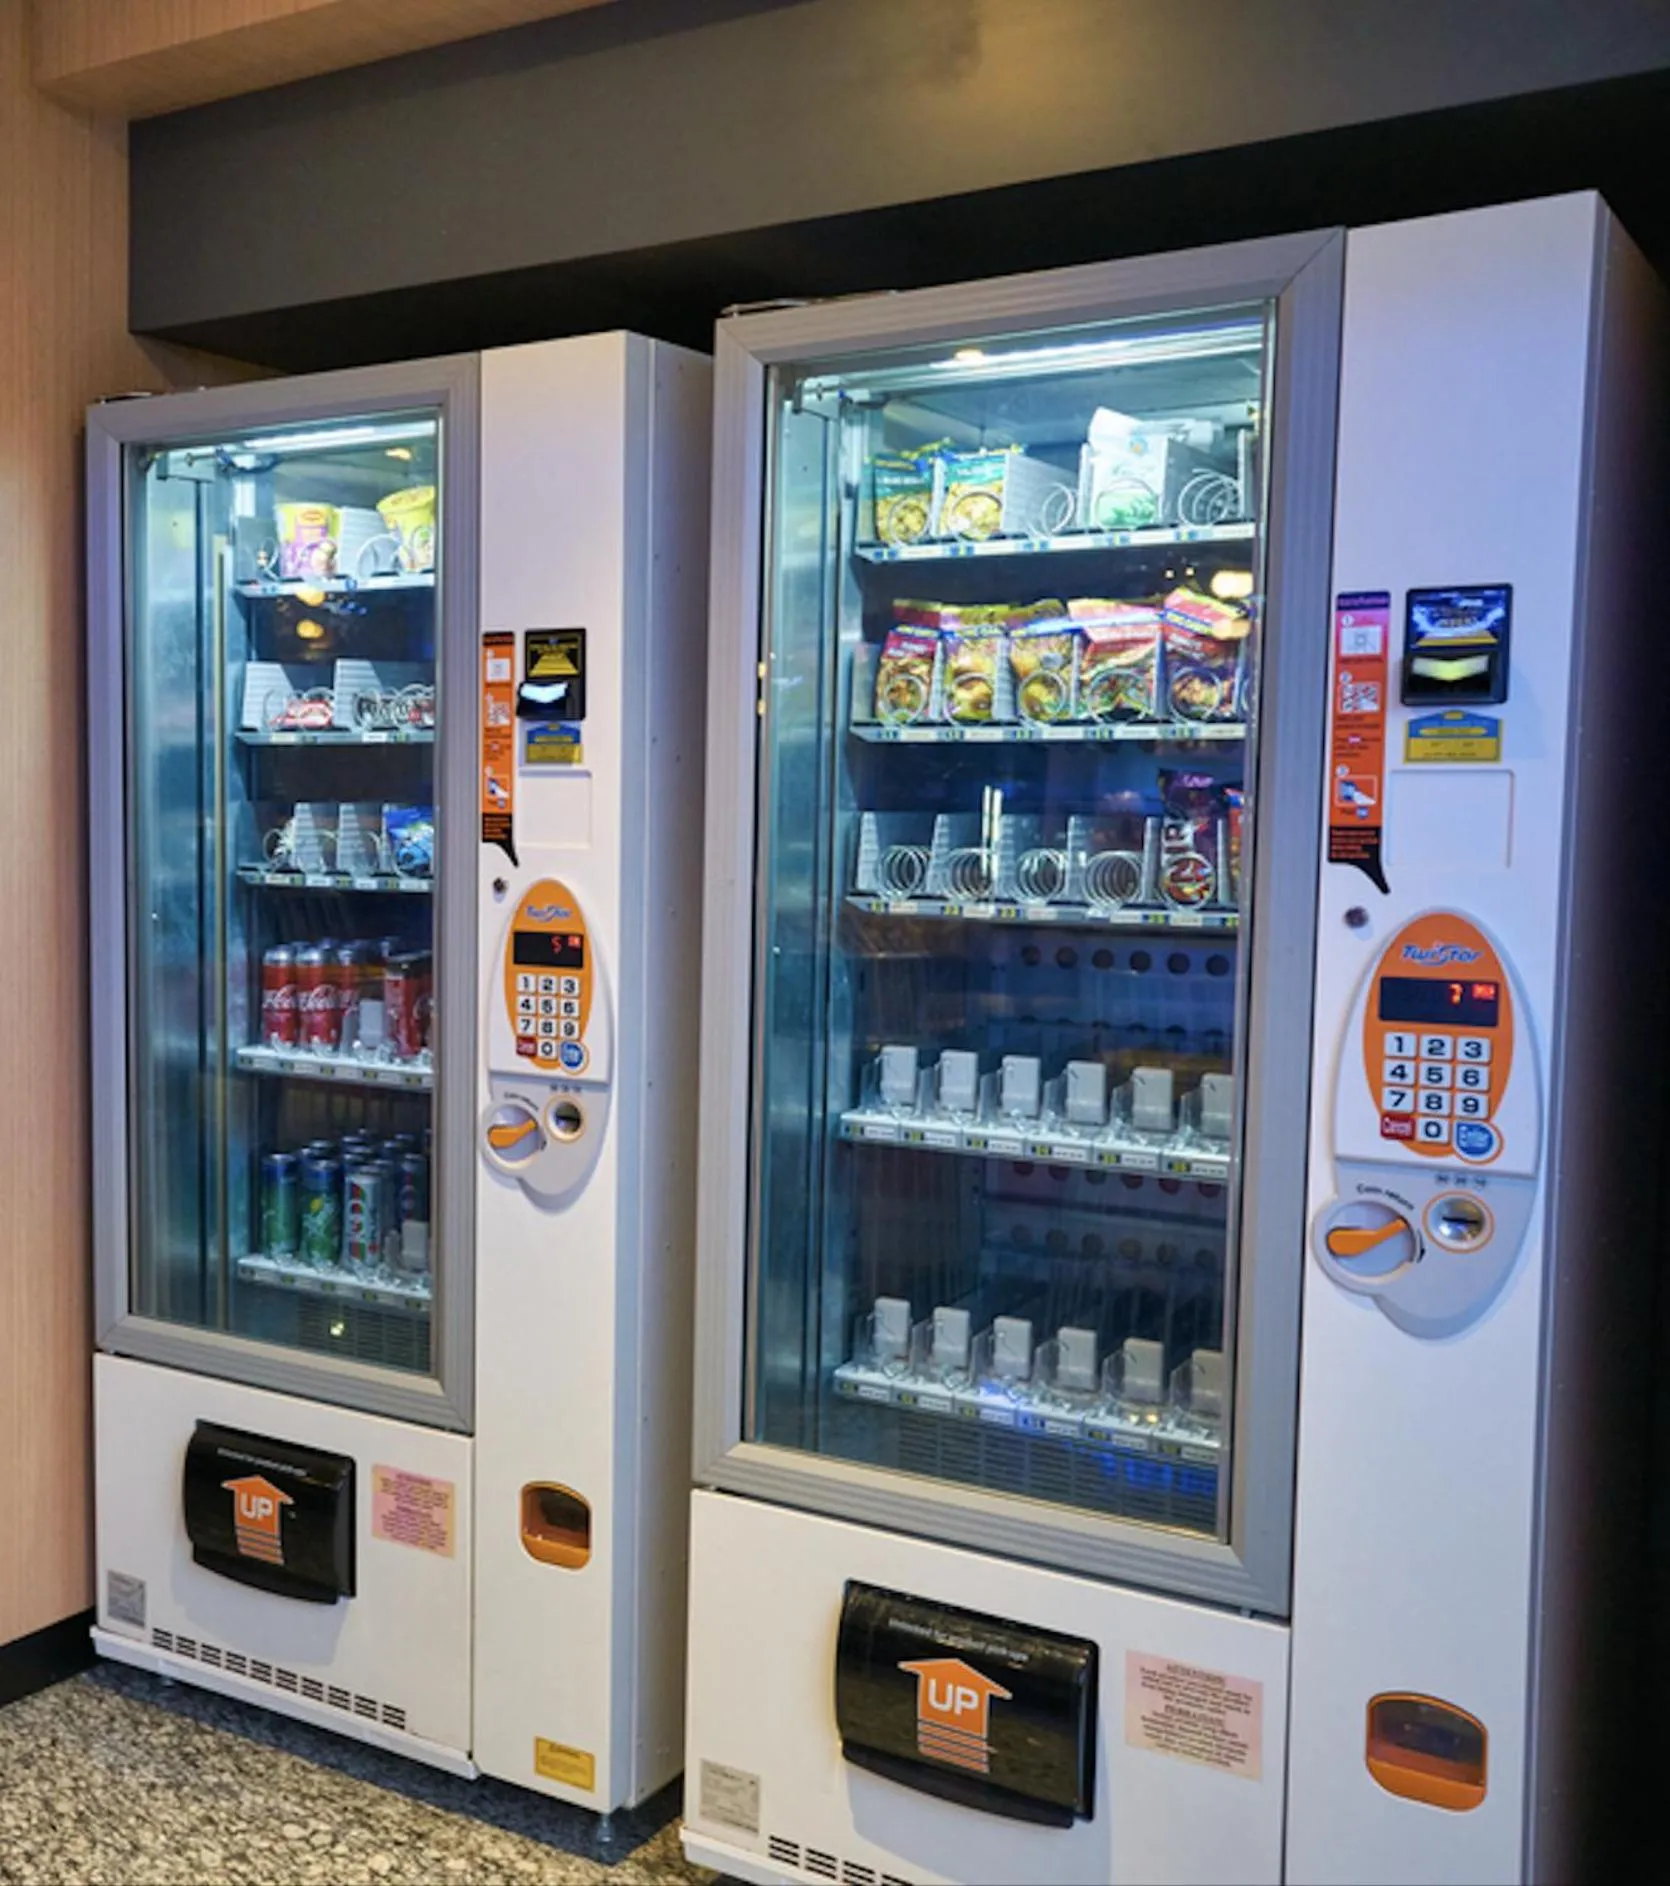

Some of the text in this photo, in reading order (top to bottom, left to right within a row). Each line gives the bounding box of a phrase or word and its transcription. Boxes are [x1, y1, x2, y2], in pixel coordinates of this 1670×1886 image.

[543, 978, 553, 991] 2
[564, 979, 575, 993] 3
[521, 998, 575, 1015] 4 5 6
[521, 1018, 575, 1036] 7 8 9
[541, 1042, 553, 1056] 0
[1393, 1036, 1483, 1058] 1 2 3
[1390, 1064, 1480, 1086] 4 5 6
[1389, 1090, 1480, 1113] 7 8 9
[1424, 1121, 1442, 1138] 0
[240, 1491, 273, 1520] UP
[928, 1678, 979, 1715] UP
